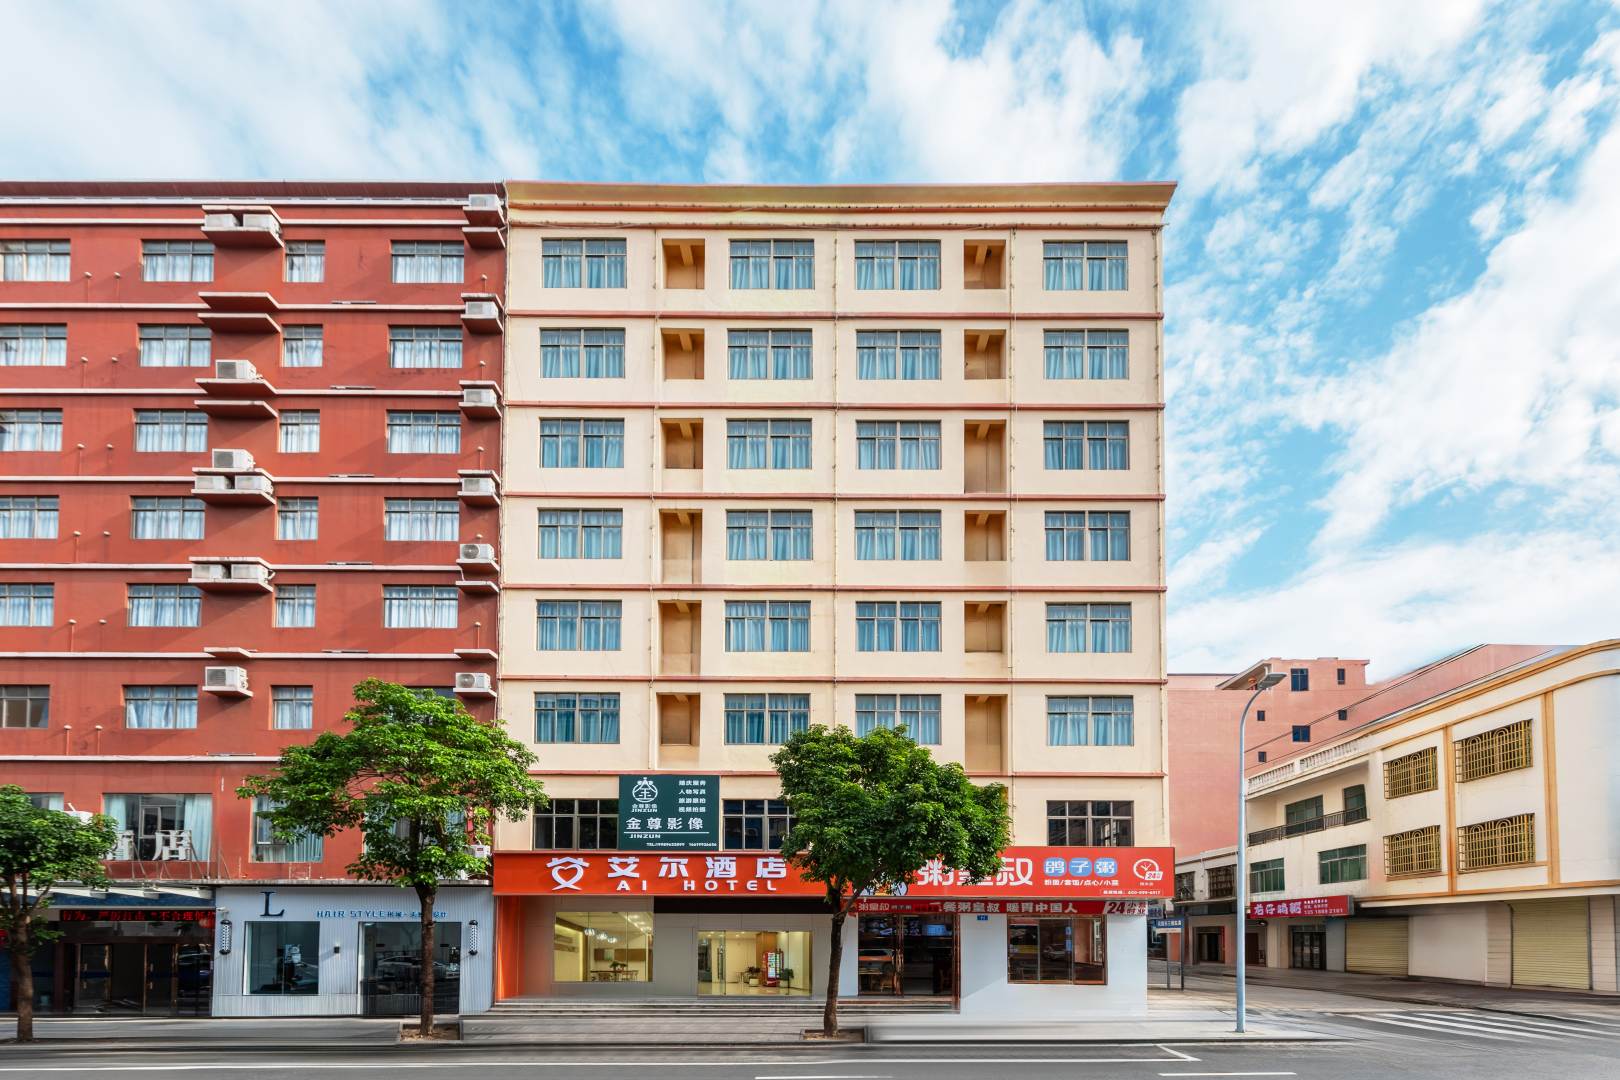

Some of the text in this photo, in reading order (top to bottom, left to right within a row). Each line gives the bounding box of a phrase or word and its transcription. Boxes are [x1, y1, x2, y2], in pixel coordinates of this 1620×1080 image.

[626, 817, 703, 830] 金尊影像
[607, 856, 787, 879] 艾尔酒店
[1045, 860, 1115, 874] 鸽子粥
[616, 879, 777, 891] AI HOTEL
[260, 891, 285, 917] L
[858, 902, 890, 912] 粥皇叔
[1006, 902, 1078, 913] 暖胃中国人
[1107, 901, 1126, 914] 24
[316, 910, 345, 918] HAIR
[350, 910, 385, 918] STYLE
